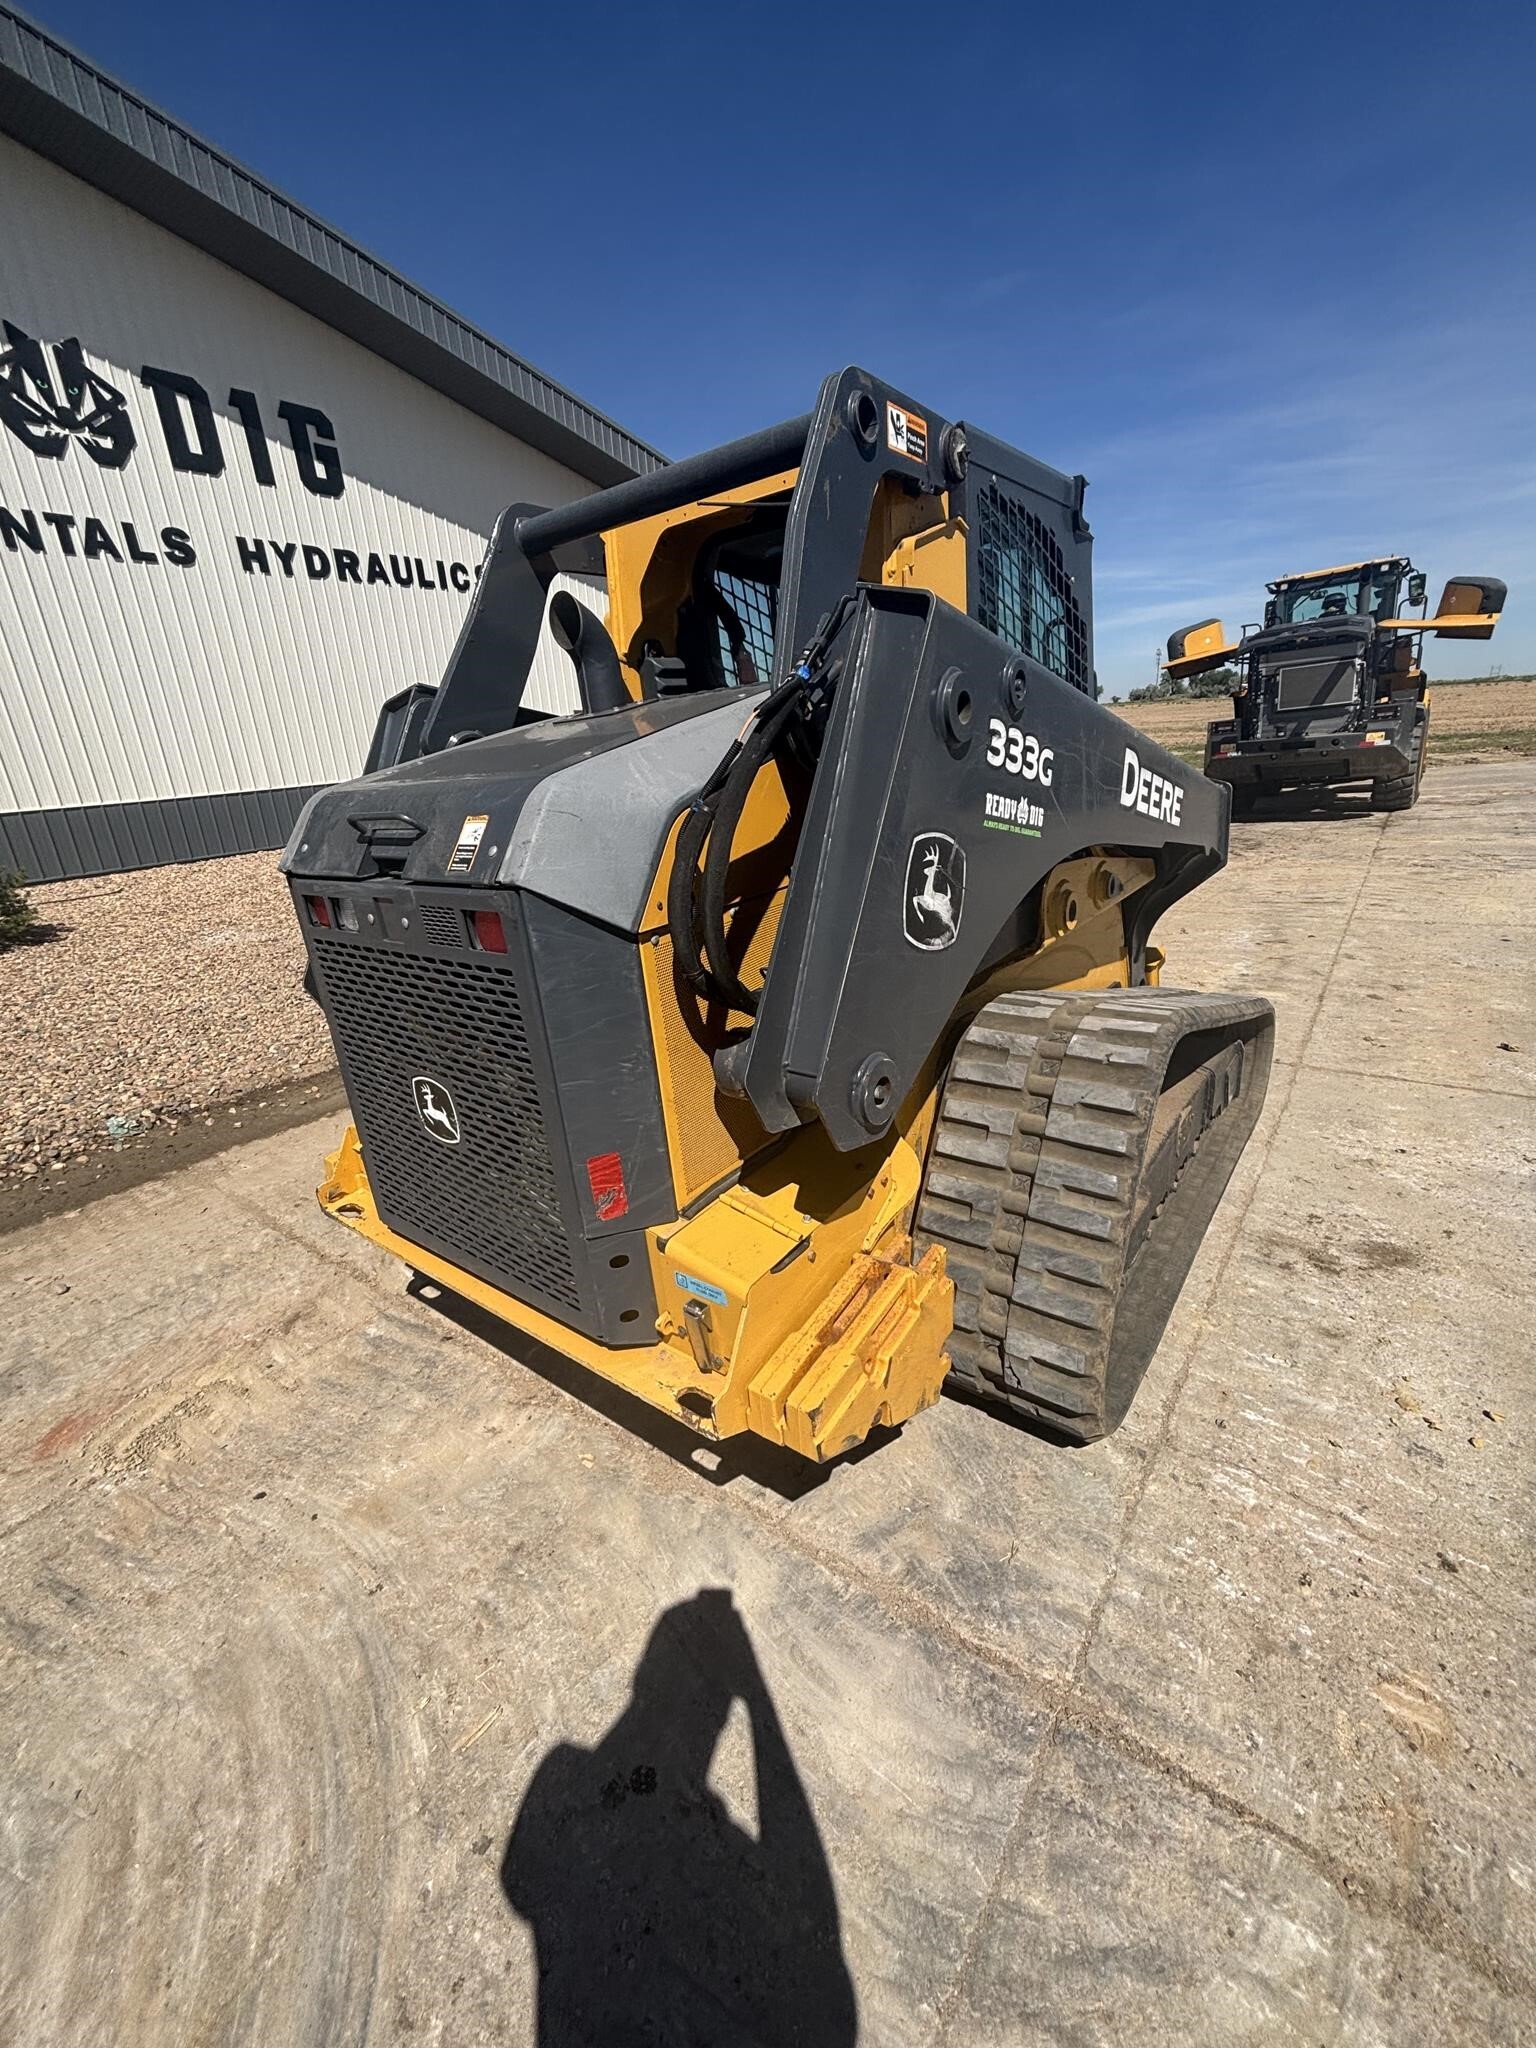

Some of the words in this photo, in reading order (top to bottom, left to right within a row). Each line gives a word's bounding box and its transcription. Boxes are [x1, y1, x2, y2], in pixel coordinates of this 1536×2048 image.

[140, 365, 346, 499] DIG
[986, 718, 1054, 787] 333G
[1120, 747, 1184, 827] DEERE
[985, 793, 1018, 820] READY
[1029, 805, 1044, 827] DIG
